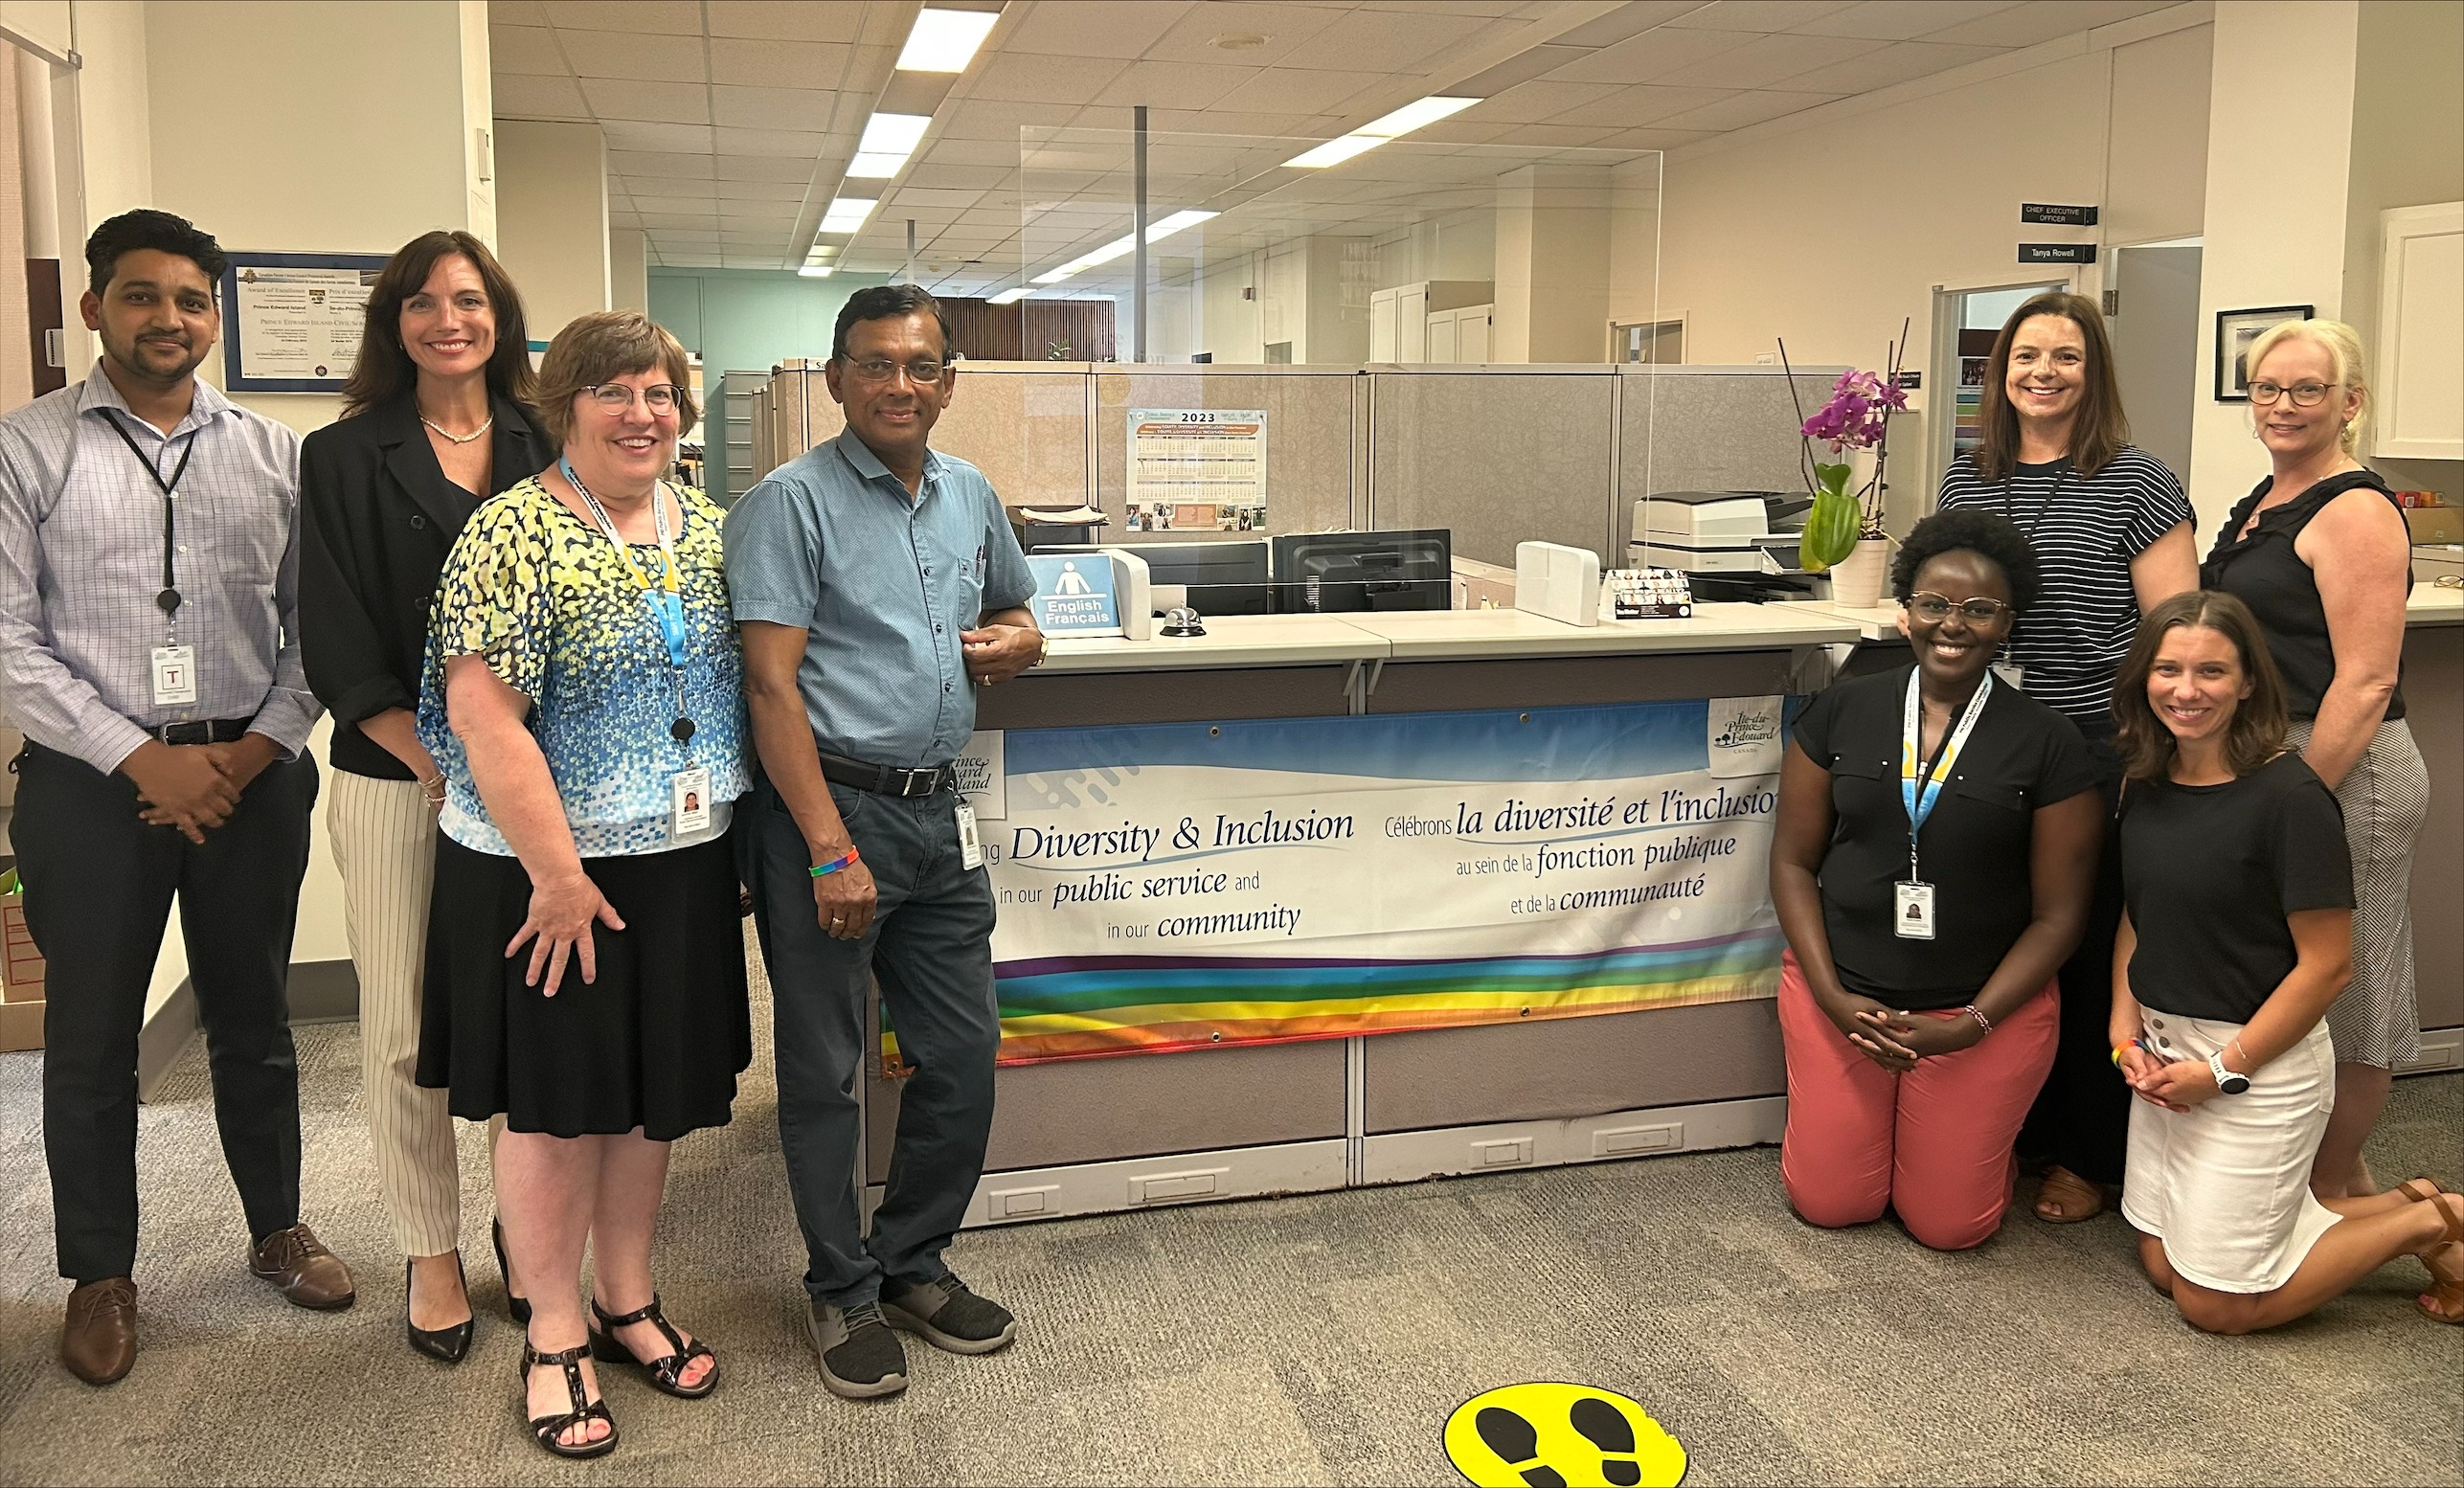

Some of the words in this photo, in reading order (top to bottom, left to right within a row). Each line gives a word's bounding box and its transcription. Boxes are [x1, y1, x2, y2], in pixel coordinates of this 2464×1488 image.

[2046, 207, 2080, 215] EXECUTIVE
[2032, 249, 2051, 259] Tanya
[1182, 413, 1215, 421] 2023
[1048, 599, 1103, 613] English
[1045, 611, 1110, 624] Français
[167, 670, 178, 684] T
[956, 755, 990, 768] ince
[958, 765, 985, 778] ard
[958, 774, 992, 790] land
[1385, 816, 1452, 838] Célébrons
[1457, 801, 1482, 835] la
[1494, 798, 1616, 832] diversité
[1623, 799, 1651, 825] et
[1008, 821, 1161, 862] Diversity
[1172, 816, 1201, 850] &
[1212, 808, 1354, 846] Inclusion
[1457, 862, 1471, 875] au
[1475, 857, 1500, 874] sein
[1503, 854, 1519, 872] de
[1523, 854, 1532, 871] la
[1534, 843, 1636, 879] fonction
[1644, 835, 1737, 871] publique
[1000, 887, 1012, 904] in
[1019, 889, 1043, 903] our
[1052, 873, 1133, 910] public
[1142, 868, 1228, 898] service
[1235, 870, 1260, 891] and
[1511, 898, 1523, 913] et
[1526, 894, 1542, 913] de
[1546, 894, 1555, 912] la
[1560, 873, 1706, 910] communauté
[1107, 921, 1120, 938] in
[1125, 923, 1149, 938] our
[1157, 903, 1301, 937] community
